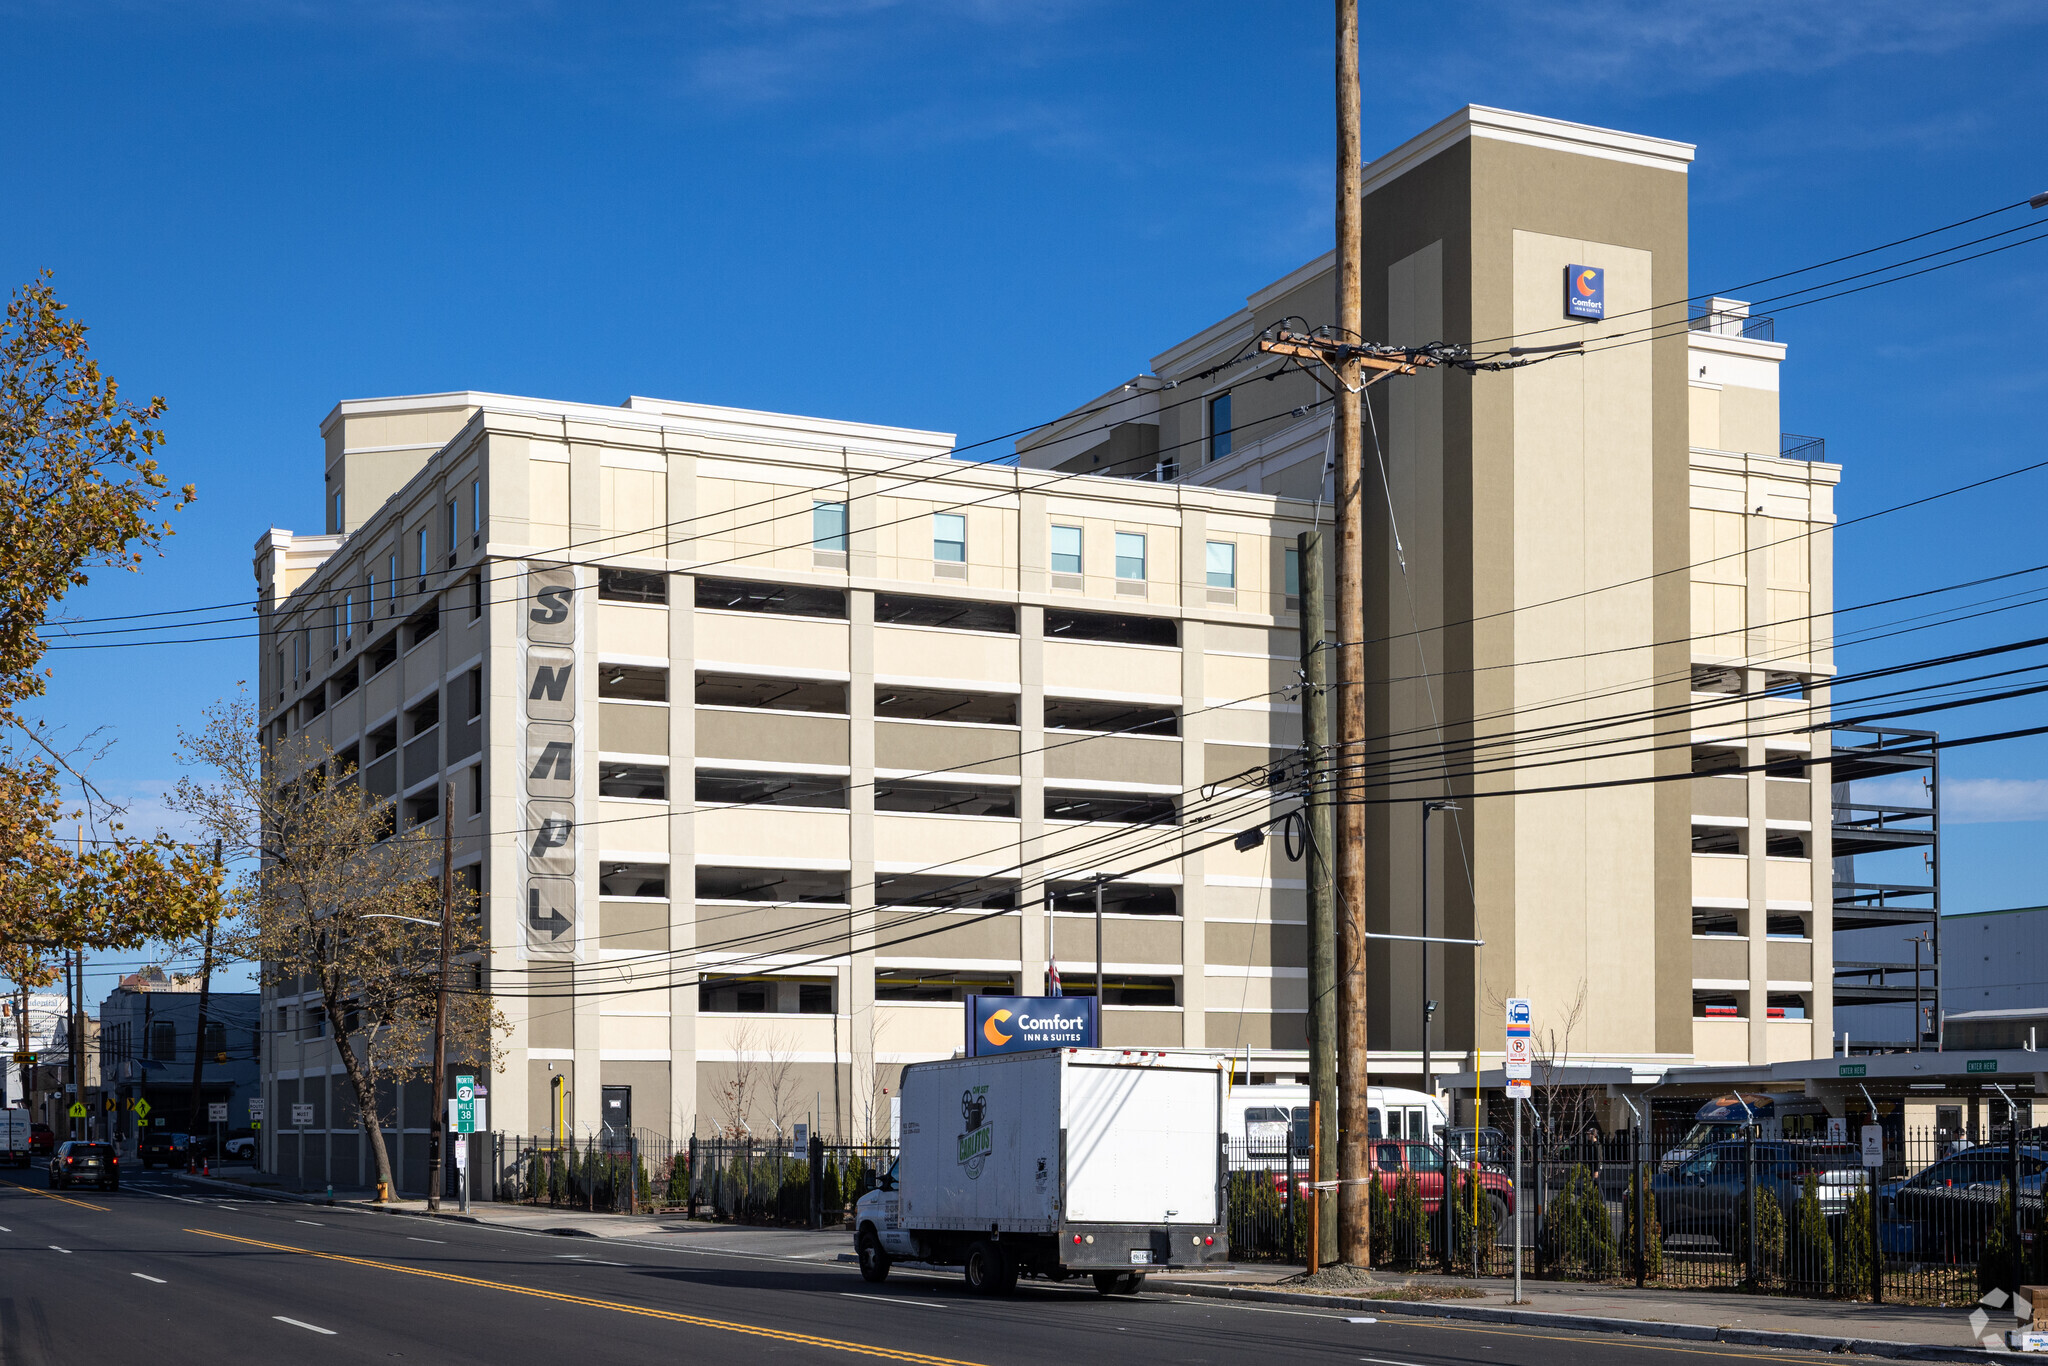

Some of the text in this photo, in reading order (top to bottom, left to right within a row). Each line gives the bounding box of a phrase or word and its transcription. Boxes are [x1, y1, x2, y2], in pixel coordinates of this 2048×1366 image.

[1572, 297, 1602, 309] Comfort
[1018, 1014, 1084, 1030] Comfort
[1050, 1033, 1081, 1041] SUITES
[1968, 1061, 1996, 1071] ENTER HERE
[1840, 1066, 1865, 1076] ENTER HERE
[460, 1089, 472, 1098] 27
[972, 1085, 989, 1094] ON SET
[458, 1102, 473, 1110] MILE
[460, 1110, 472, 1119] 38
[960, 1127, 990, 1161] CARLITOS
